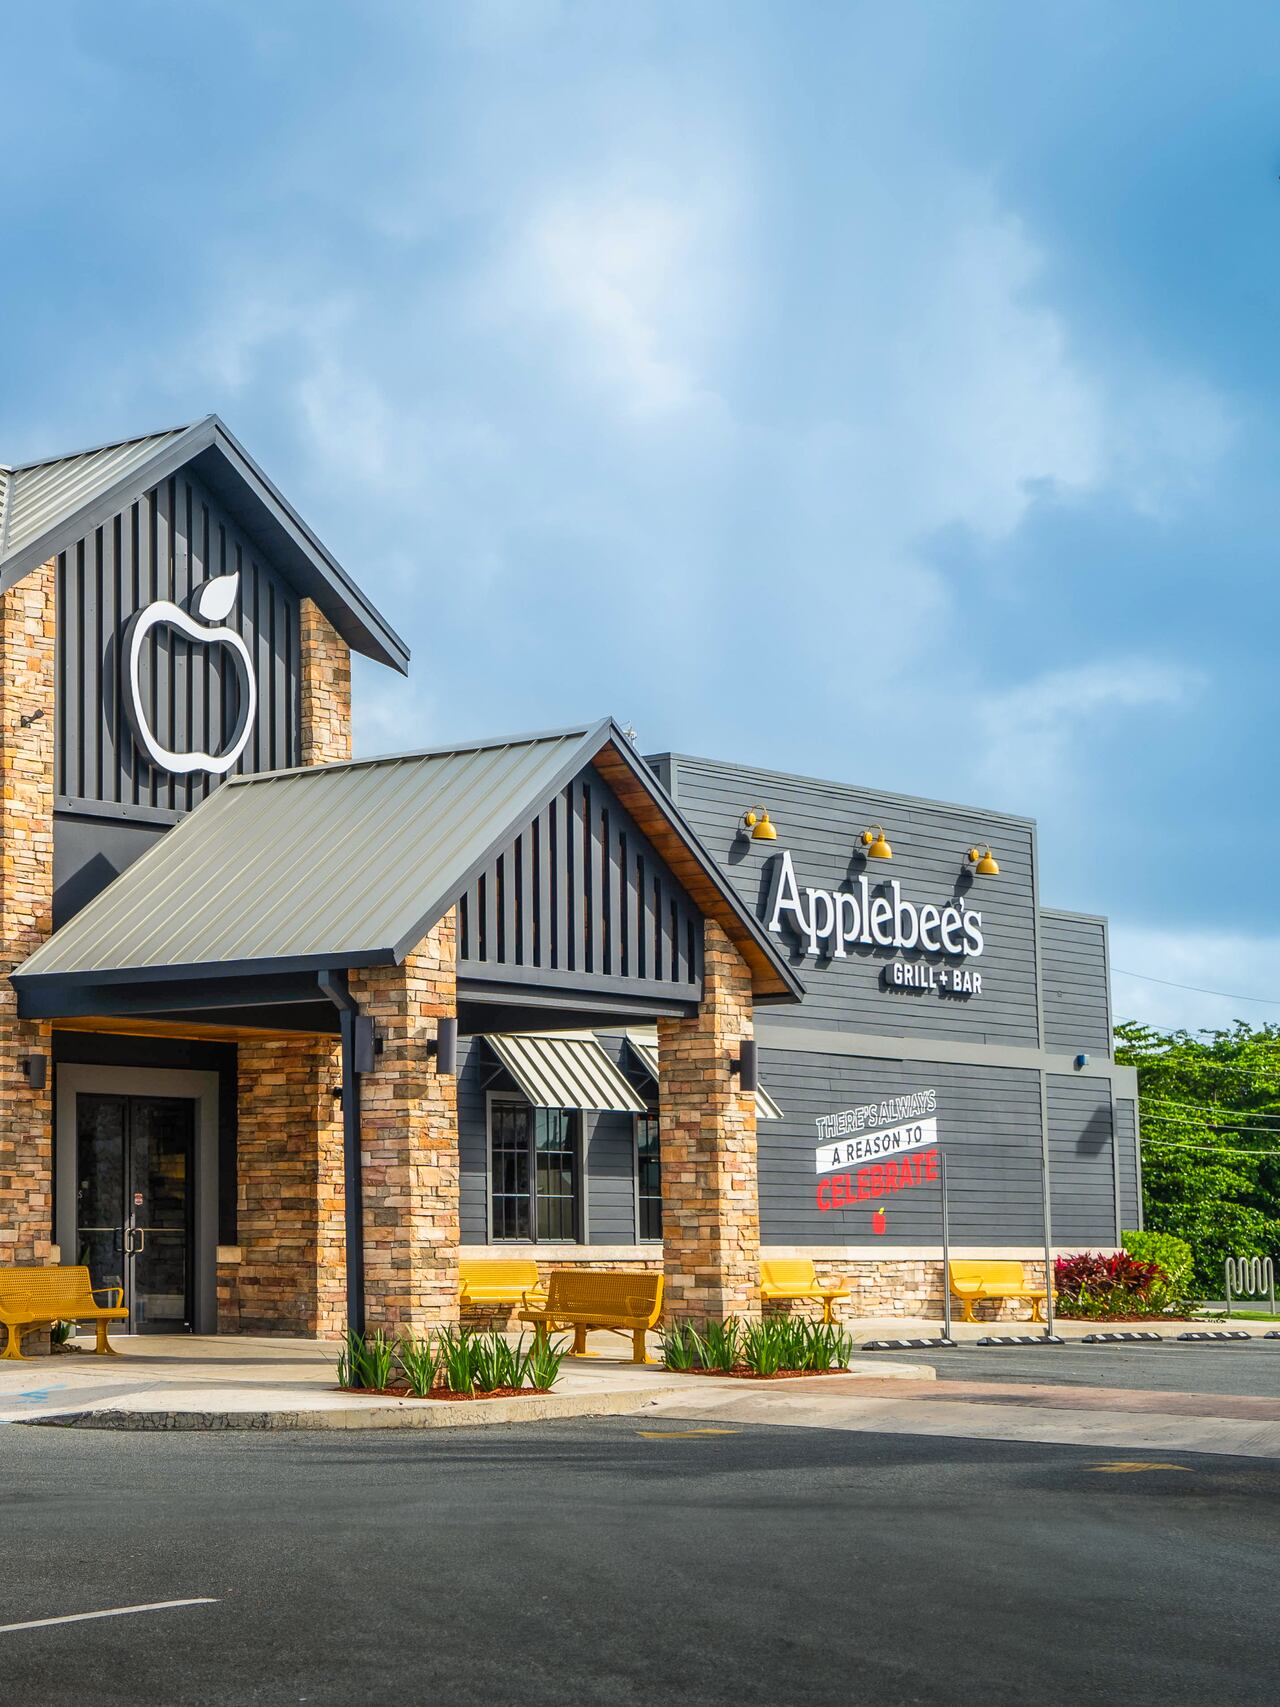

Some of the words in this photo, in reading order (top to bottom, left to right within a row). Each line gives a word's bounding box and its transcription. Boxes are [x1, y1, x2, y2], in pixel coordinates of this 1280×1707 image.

[769, 850, 984, 958] Applebee's
[893, 962, 937, 989] GRILL
[953, 969, 982, 994] BAR
[815, 1104, 878, 1140] THERE'S
[879, 1089, 937, 1125] ALWAYS
[832, 1147, 841, 1166] A
[846, 1131, 901, 1162] REASON
[906, 1125, 923, 1145] TO
[815, 1148, 938, 1212] CELEBRATE
